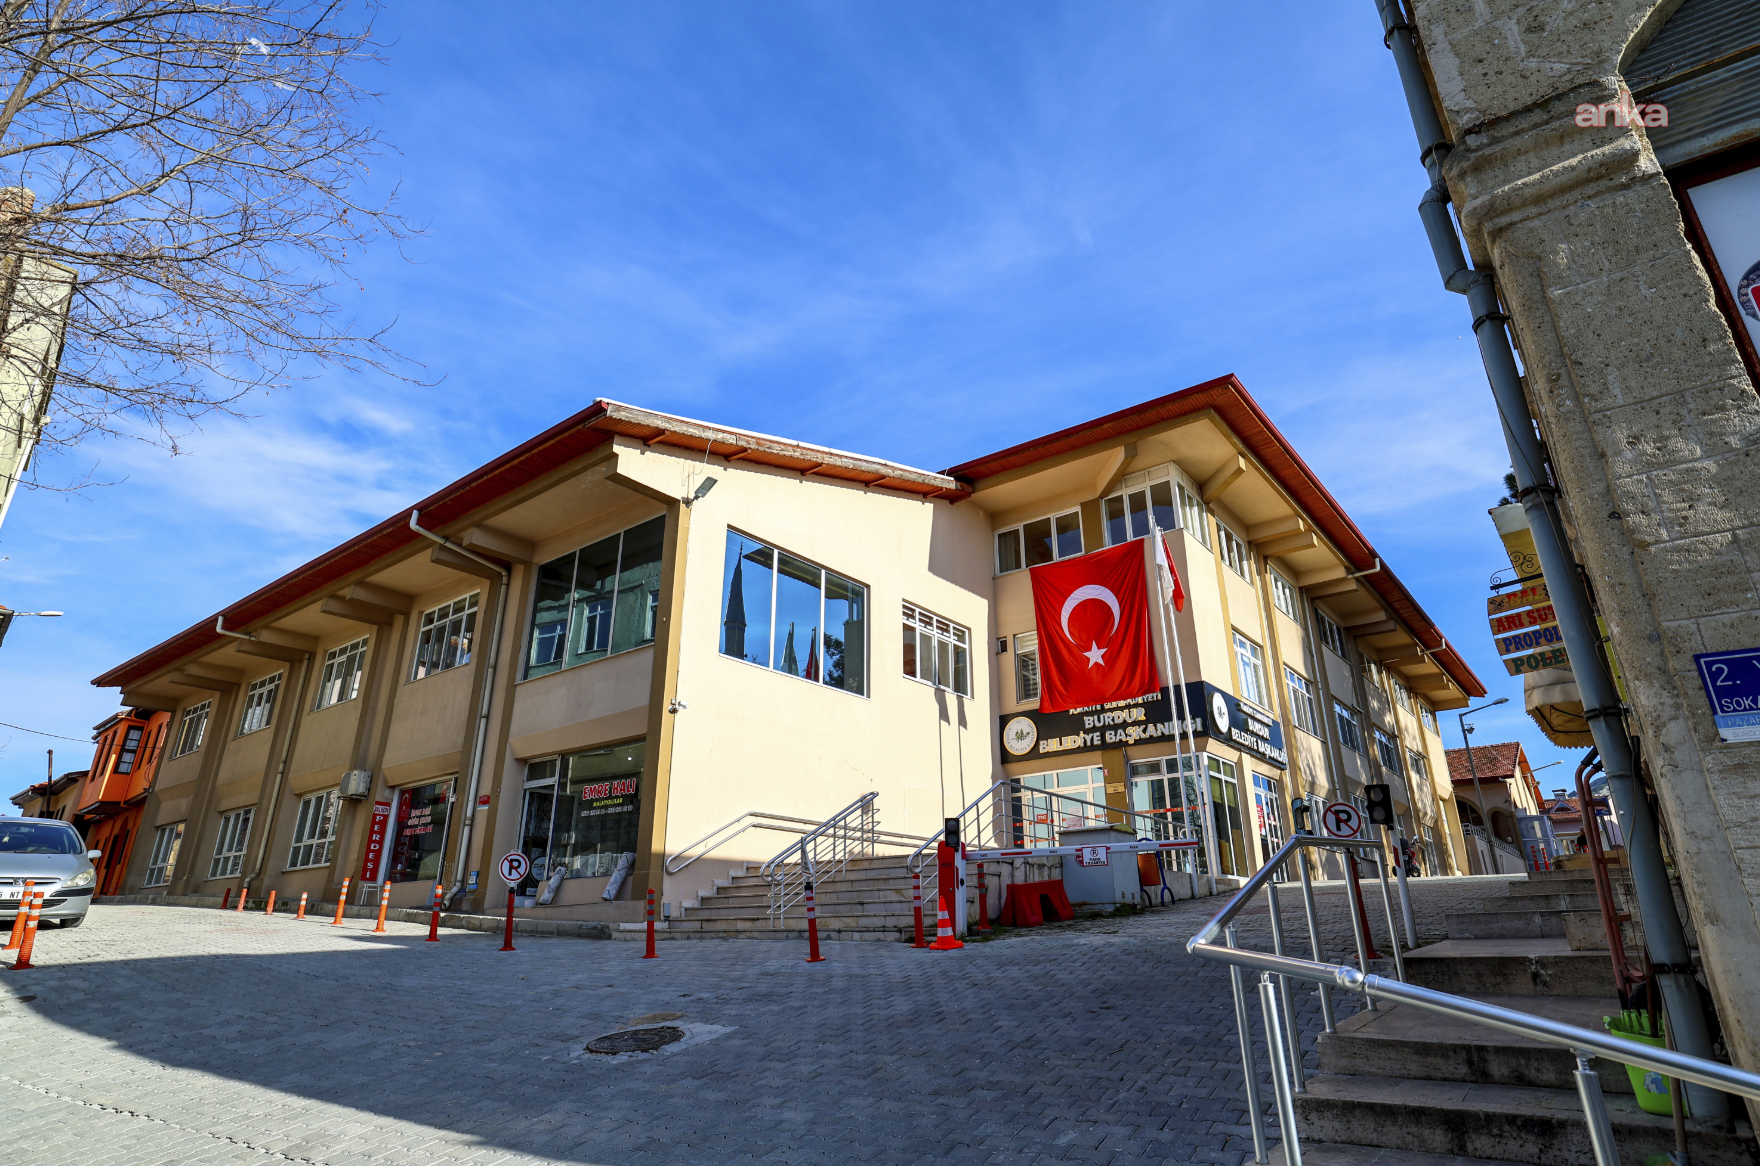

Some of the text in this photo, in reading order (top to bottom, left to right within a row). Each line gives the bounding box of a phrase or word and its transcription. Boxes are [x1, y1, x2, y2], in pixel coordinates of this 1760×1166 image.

[1506, 587, 1544, 607] BAL
[1496, 610, 1525, 633] ARI
[1512, 647, 1569, 674] POLE
[1711, 663, 1741, 686] 2.
[1084, 707, 1146, 729] BURDUR
[1039, 731, 1102, 754] BELEDİYE
[582, 778, 636, 800] EMRE HALI
[366, 815, 384, 878] PERDESİ
